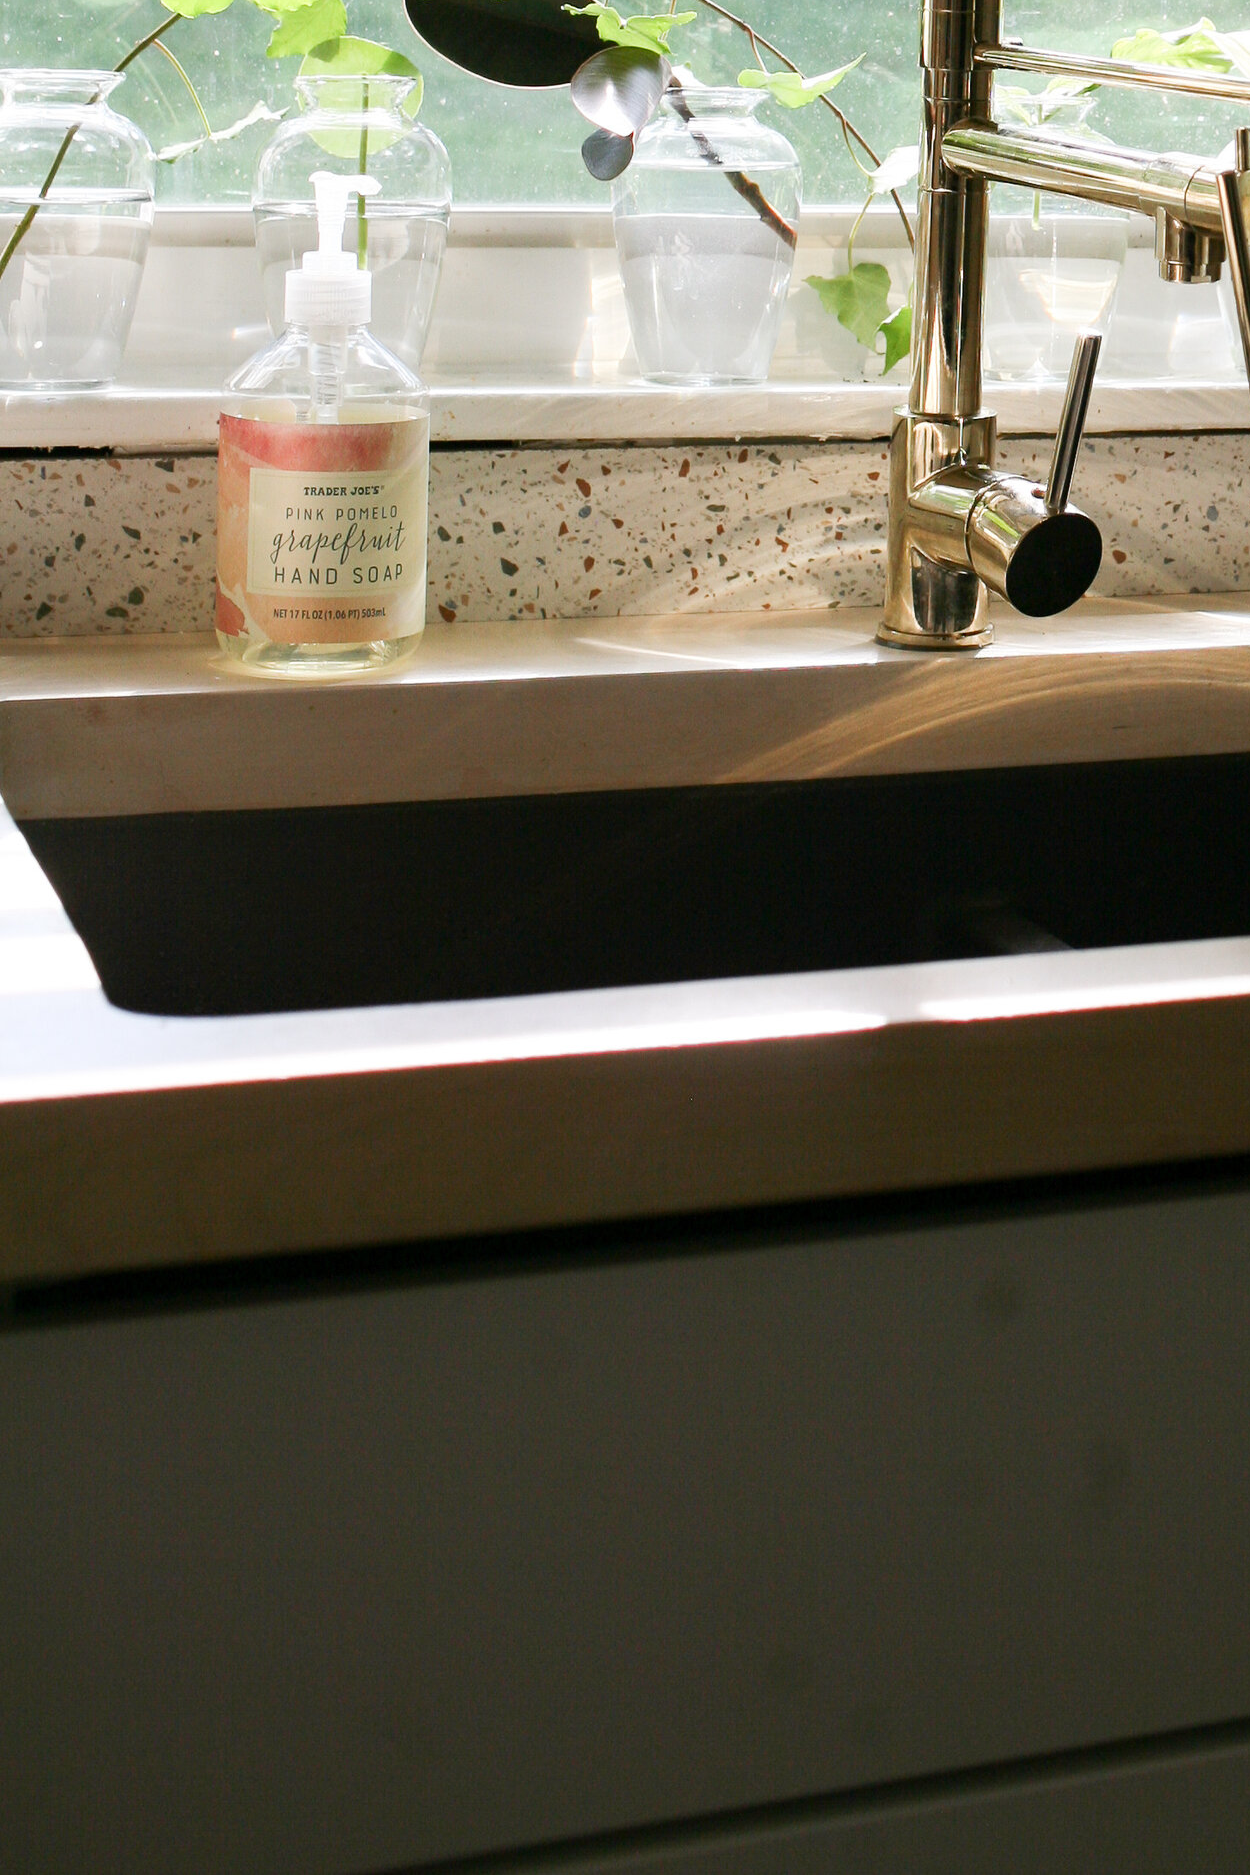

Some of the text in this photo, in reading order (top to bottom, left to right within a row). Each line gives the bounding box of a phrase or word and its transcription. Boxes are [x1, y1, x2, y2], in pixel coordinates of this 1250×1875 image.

[303, 485, 380, 496] TRADER JOE'S
[285, 505, 398, 521] PINK POMELO
[269, 521, 406, 565] grapefruit
[274, 563, 403, 585] HAND SOAP
[273, 608, 288, 618] NET
[290, 609, 299, 619] 17
[301, 609, 310, 620] FL
[312, 609, 323, 620] OZ
[324, 609, 347, 621] (1.06
[348, 608, 360, 621] PT)
